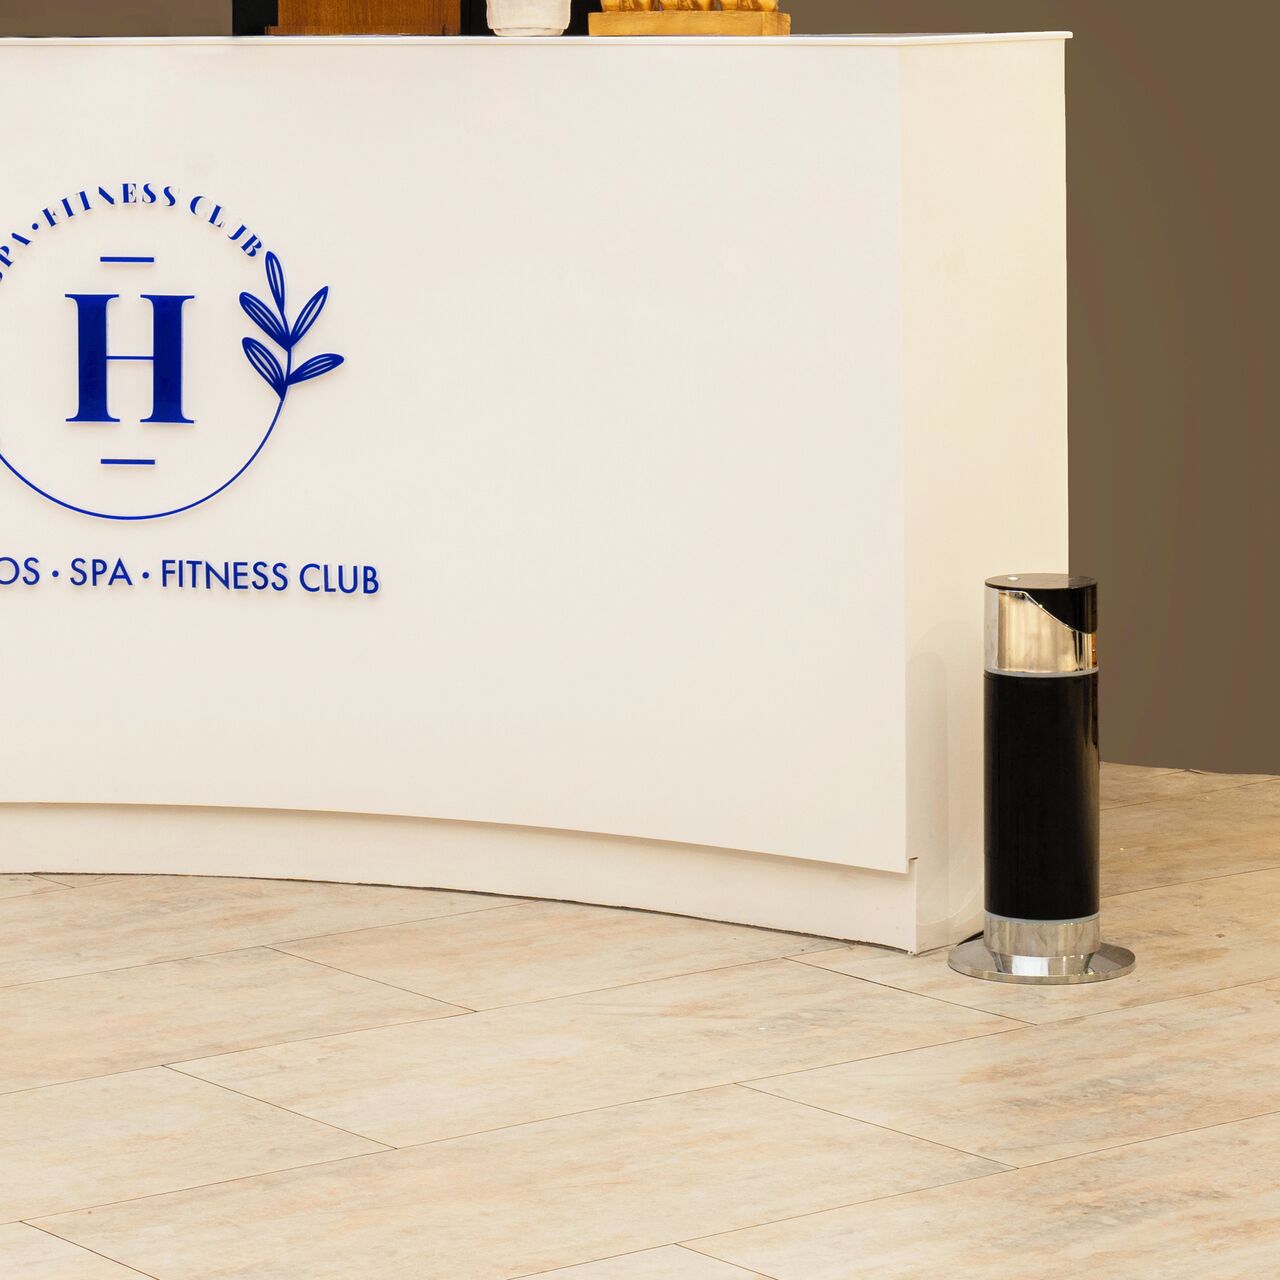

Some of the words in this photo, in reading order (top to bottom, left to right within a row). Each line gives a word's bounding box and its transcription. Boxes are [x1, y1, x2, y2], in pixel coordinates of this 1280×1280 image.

[66, 293, 195, 425] H
[70, 557, 132, 587] SPA
[161, 559, 289, 592] FITNESS
[298, 563, 381, 595] CLUB
